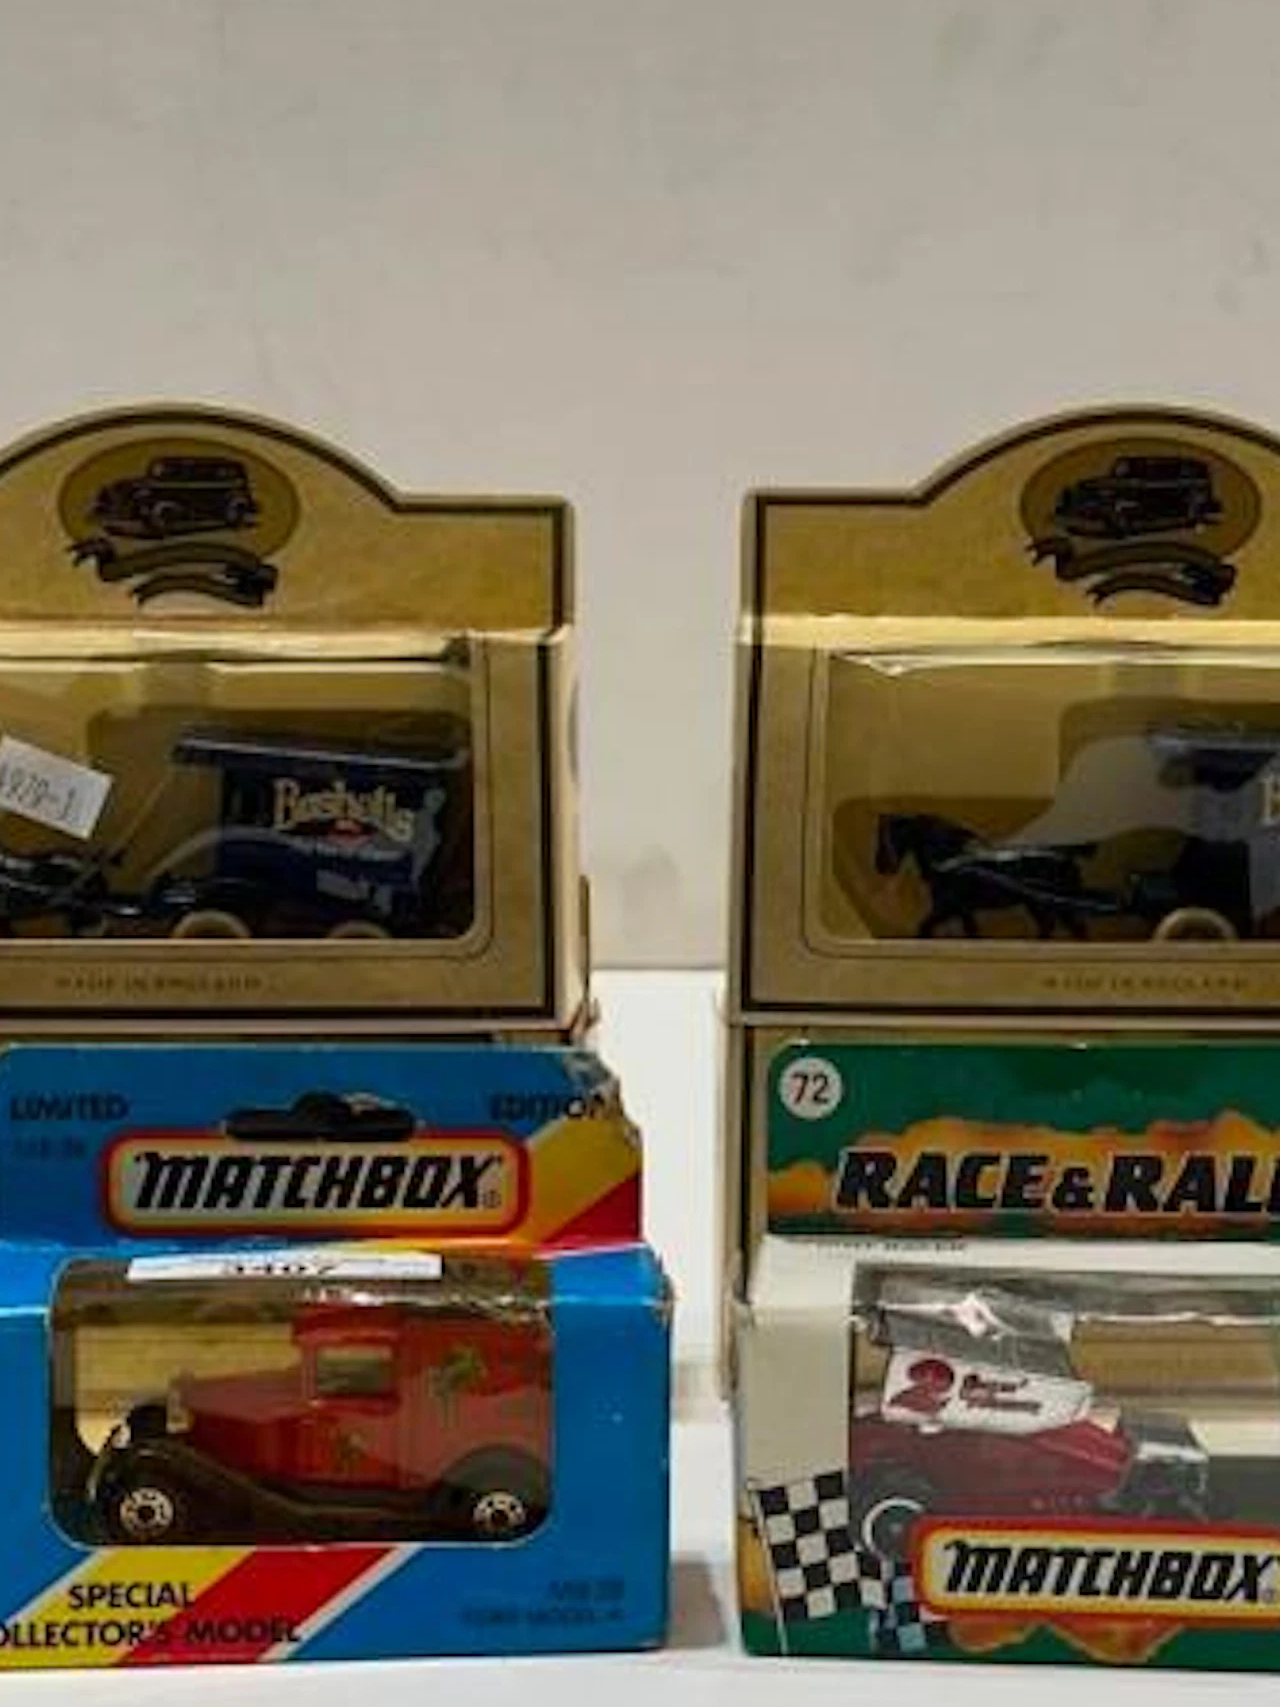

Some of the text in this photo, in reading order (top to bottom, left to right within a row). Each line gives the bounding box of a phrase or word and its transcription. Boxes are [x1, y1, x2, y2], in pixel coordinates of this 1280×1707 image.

[788, 1072, 831, 1106] 72
[132, 1151, 503, 1209] MATCHBOX
[887, 1358, 955, 1412] 2
[67, 1580, 194, 1610] SPECIAL
[187, 1616, 300, 1644] MODEL
